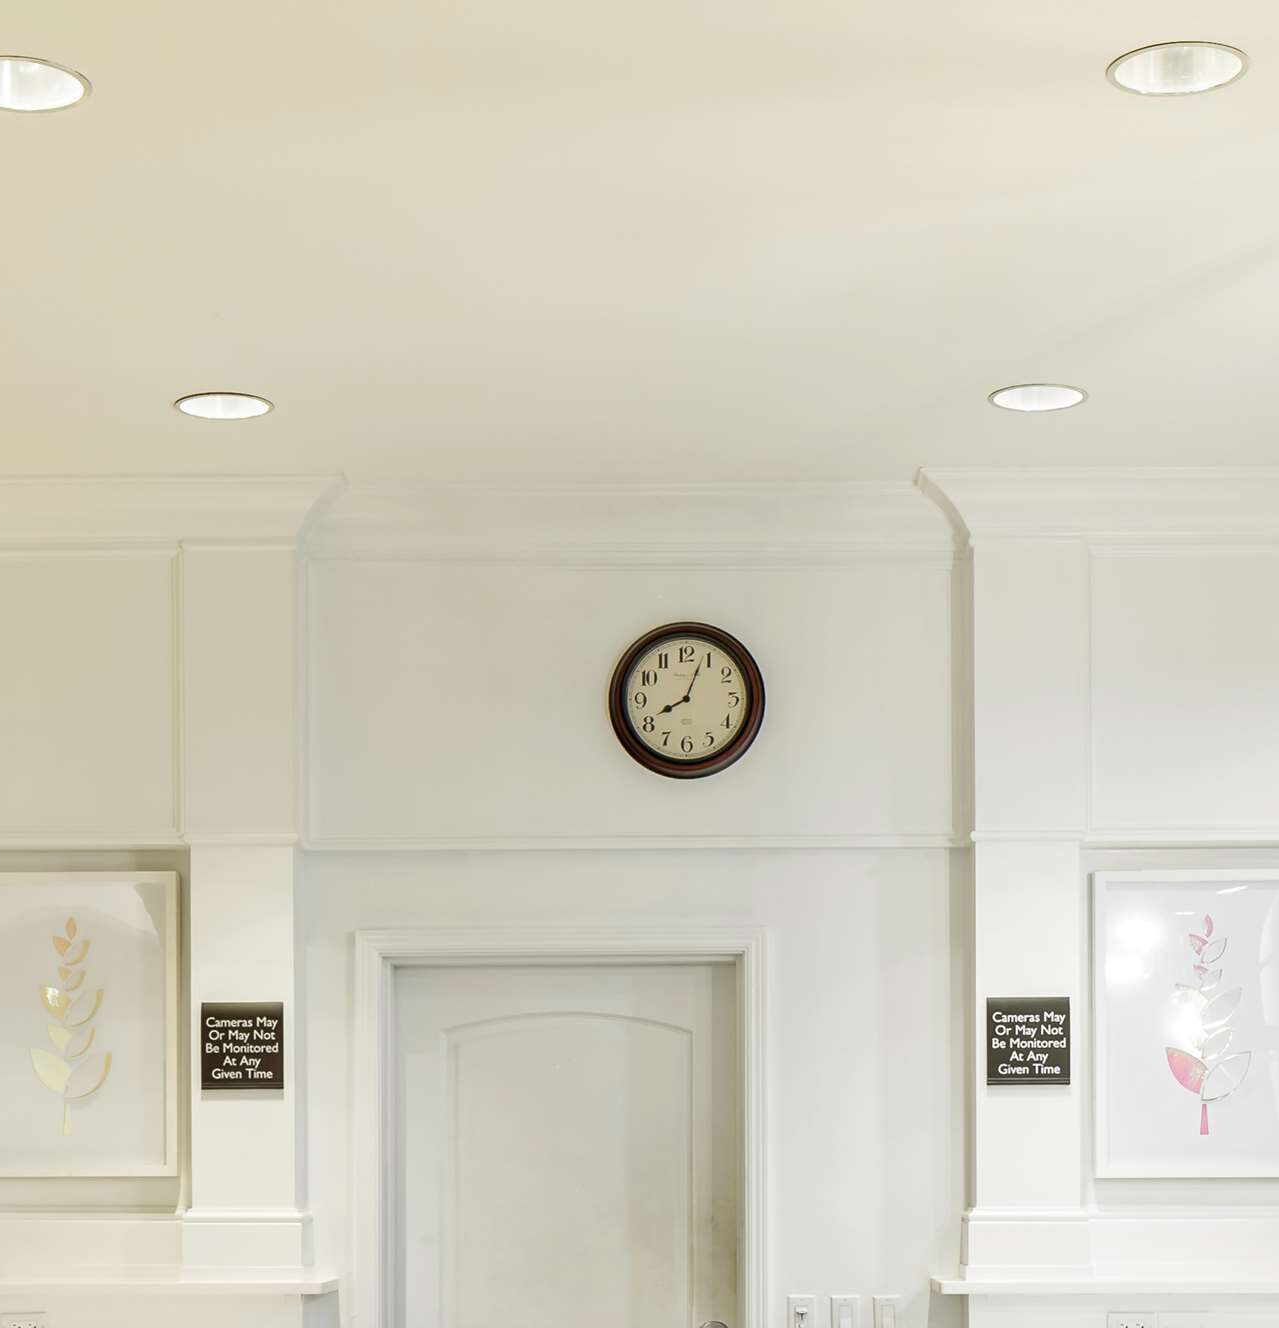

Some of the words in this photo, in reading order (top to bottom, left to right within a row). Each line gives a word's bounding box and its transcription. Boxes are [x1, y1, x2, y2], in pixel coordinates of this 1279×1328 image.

[658, 652, 669, 669] 11
[678, 646, 695, 663] 12
[706, 652, 712, 668] 1
[641, 670, 658, 686] 10
[720, 666, 732, 684] 2
[634, 692, 648, 709] 9
[642, 716, 655, 733] 8
[720, 713, 733, 729] 4
[662, 730, 672, 746] 7
[680, 736, 694, 753] 6
[702, 732, 715, 747] 5
[206, 1016, 253, 1028] Cameras
[256, 1016, 278, 1030] May
[992, 1012, 1040, 1022] Cameras
[1044, 1011, 1066, 1025] May
[208, 1030, 225, 1040] Or
[228, 1030, 250, 1043] May
[254, 1030, 276, 1040] Not
[995, 1024, 1012, 1036] Or
[1015, 1024, 1038, 1038] May
[1040, 1024, 1064, 1036] Not
[206, 1042, 220, 1054] Be
[222, 1042, 279, 1054] Monitored
[992, 1038, 1006, 1048] Be
[1010, 1037, 1066, 1048] Monitored
[222, 1056, 237, 1066] At
[240, 1056, 261, 1069] Any
[1010, 1050, 1024, 1061] At
[1026, 1050, 1048, 1064] Any
[212, 1068, 242, 1079] Given
[245, 1068, 273, 1079] Time
[998, 1064, 1030, 1074] Given
[1032, 1063, 1061, 1074] Time
